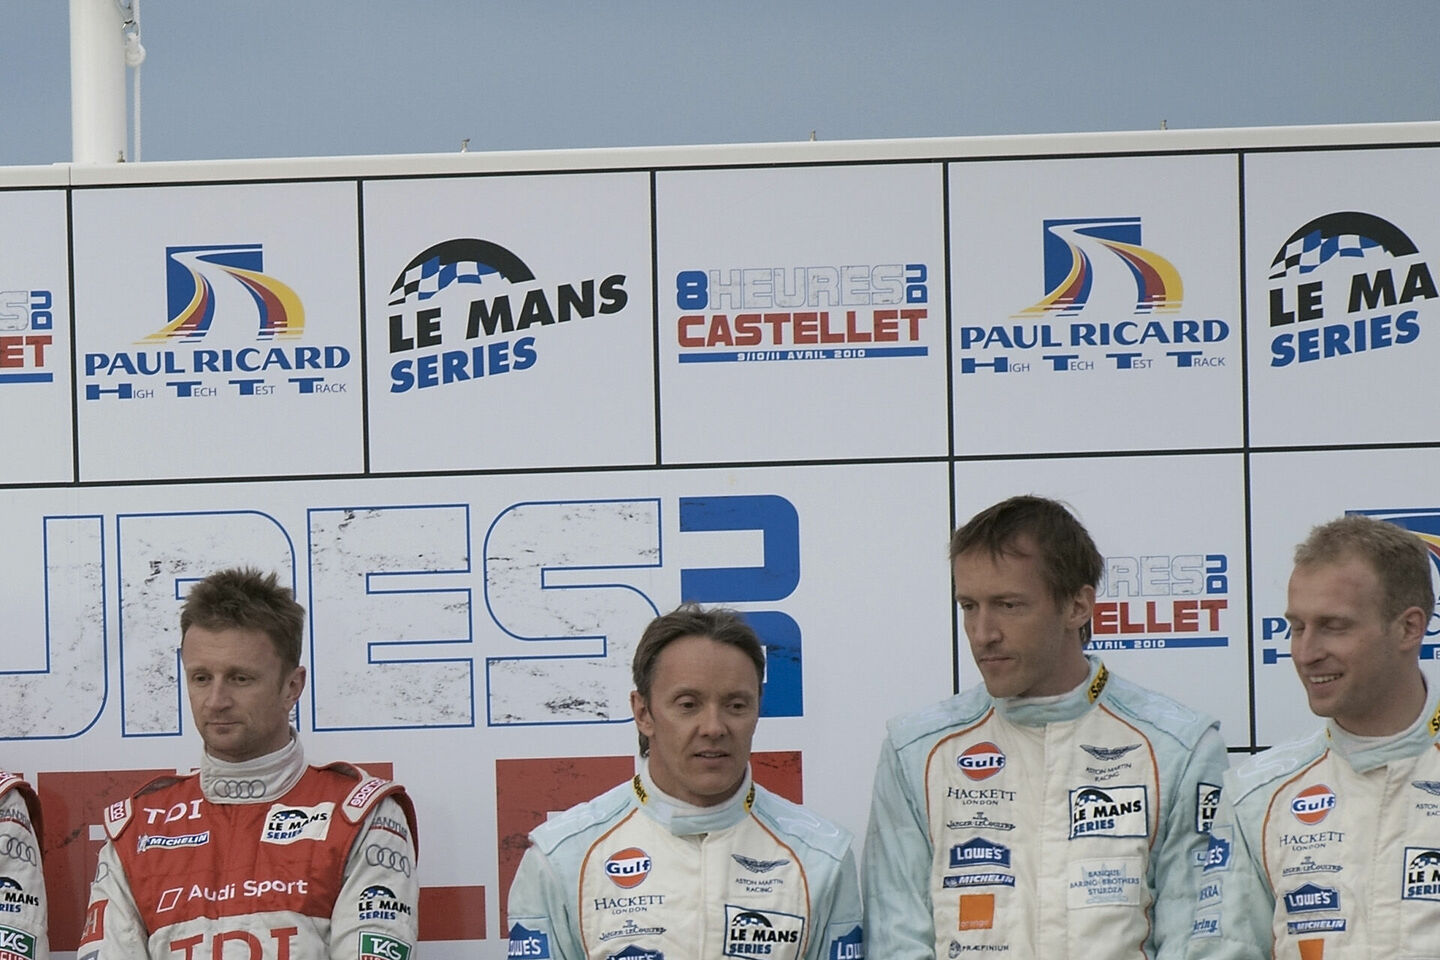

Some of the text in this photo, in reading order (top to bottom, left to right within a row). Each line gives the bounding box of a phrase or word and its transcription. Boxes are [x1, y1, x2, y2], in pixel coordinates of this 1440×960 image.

[677, 263, 928, 311] 8 HEURES DU
[30, 290, 52, 330] DU
[1269, 281, 1323, 327] LE
[389, 274, 629, 353] LE MANS
[678, 309, 928, 347] CASTELLET
[960, 319, 1230, 351] PAUL RICARD
[1270, 310, 1421, 367] SERIES
[85, 345, 351, 376] PAUL RICARD
[786, 349, 867, 360] AVRIL 2010
[961, 350, 1226, 374] HIGH TECH TEST TRACK
[389, 336, 538, 394] SERIES
[85, 377, 347, 400] HIGH TECH TEST TRACK
[959, 754, 1005, 769] Gulf
[947, 786, 1016, 802] HACKETT
[143, 799, 203, 824] TDI
[1094, 800, 1142, 818] MANS
[1292, 796, 1336, 812] Gulf
[269, 812, 327, 831] LE MANS
[1073, 819, 1116, 836] SERIES
[150, 832, 209, 847] MICHELIN
[267, 829, 304, 840] SERIES
[1279, 831, 1345, 848] HACKETT
[607, 860, 651, 875] Gulf
[959, 874, 1014, 886] MICHELIN
[1408, 872, 1425, 884] LE
[188, 879, 308, 902] Audi Sport
[5, 893, 40, 907] MANS
[594, 894, 665, 911] HACKETT
[359, 911, 396, 921] SERIES
[1297, 919, 1345, 930] MICHELIN
[730, 929, 798, 943] LE MANS
[370, 937, 402, 960] TAG
[729, 943, 772, 955] SERIES
